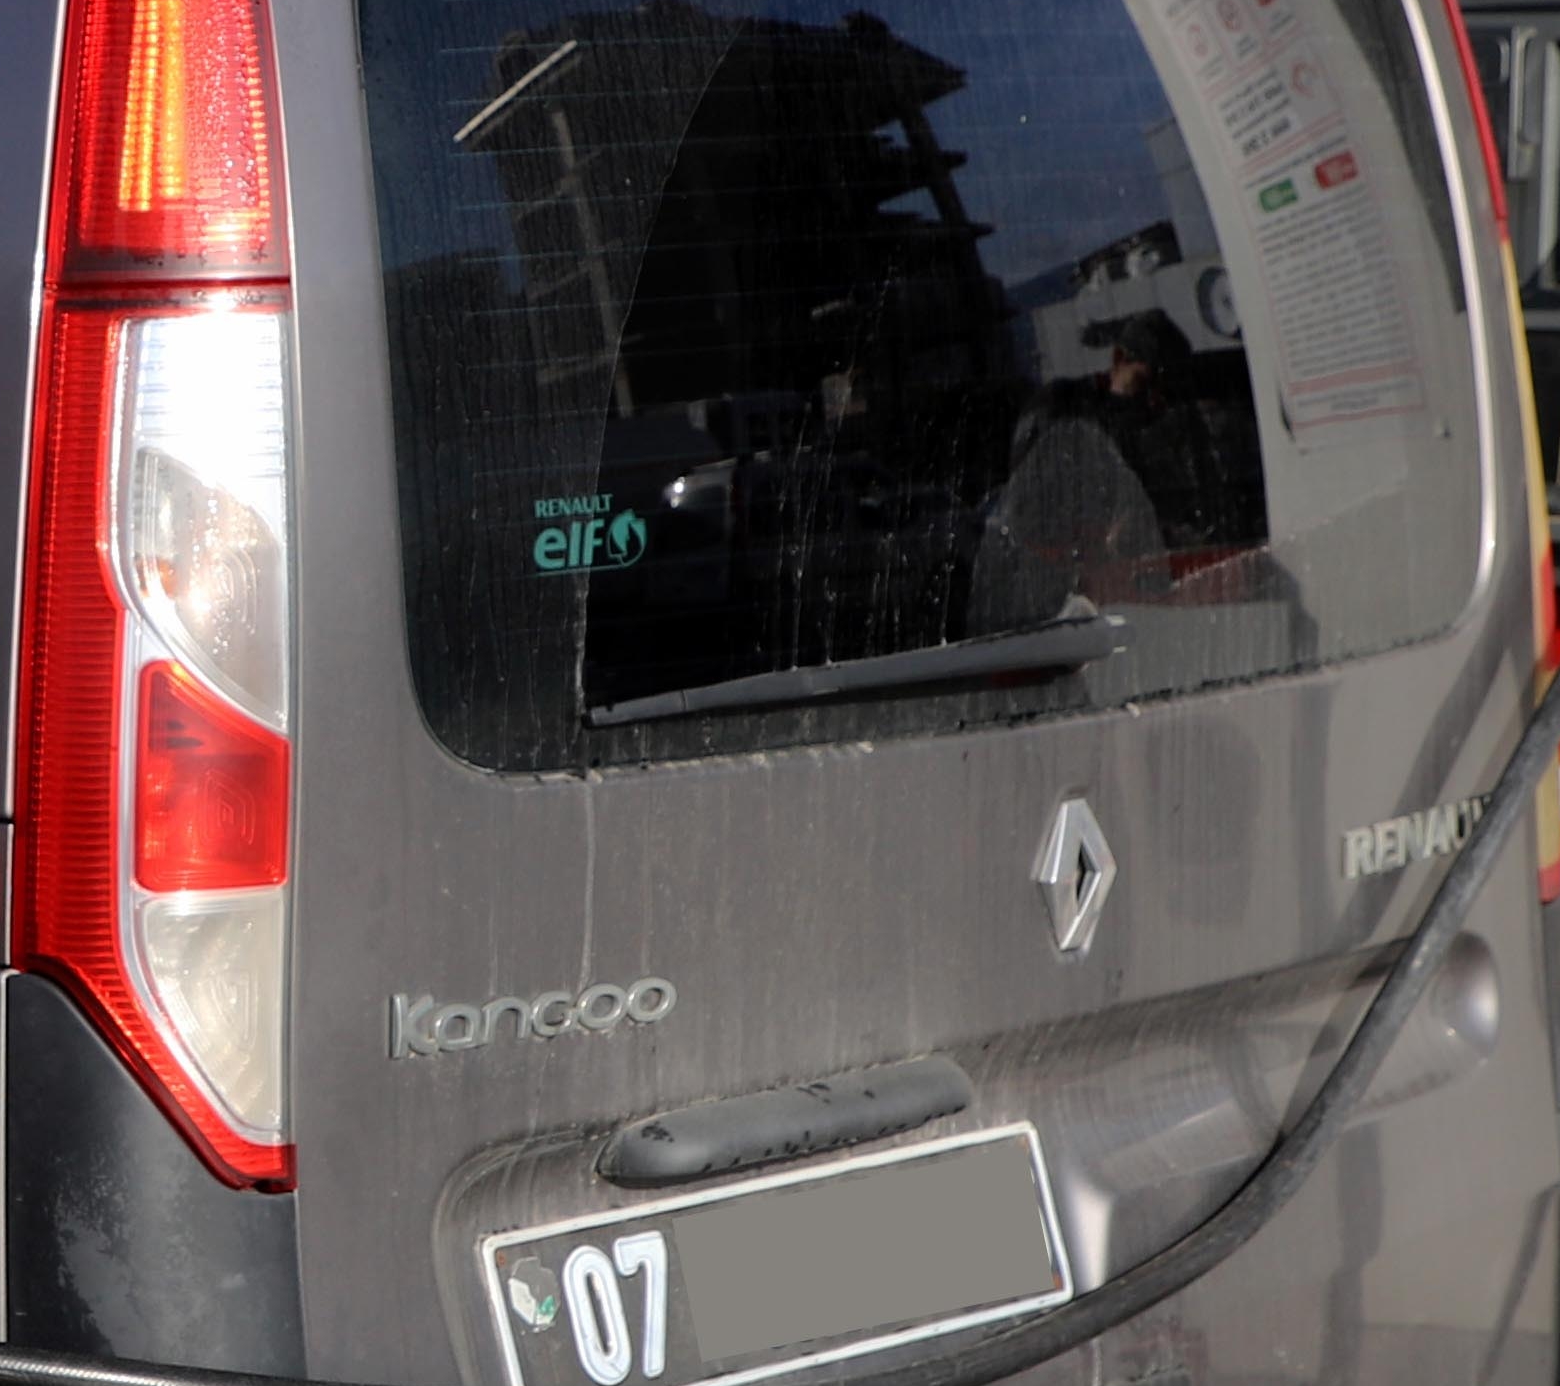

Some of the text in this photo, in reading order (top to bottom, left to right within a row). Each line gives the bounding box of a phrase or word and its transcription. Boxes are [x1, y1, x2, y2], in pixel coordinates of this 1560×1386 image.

[534, 518, 605, 569] elf
[535, 494, 613, 518] RENAULT
[1342, 793, 1492, 879] RENAU
[389, 977, 678, 1059] Kangoo
[563, 1230, 668, 1386] 07
